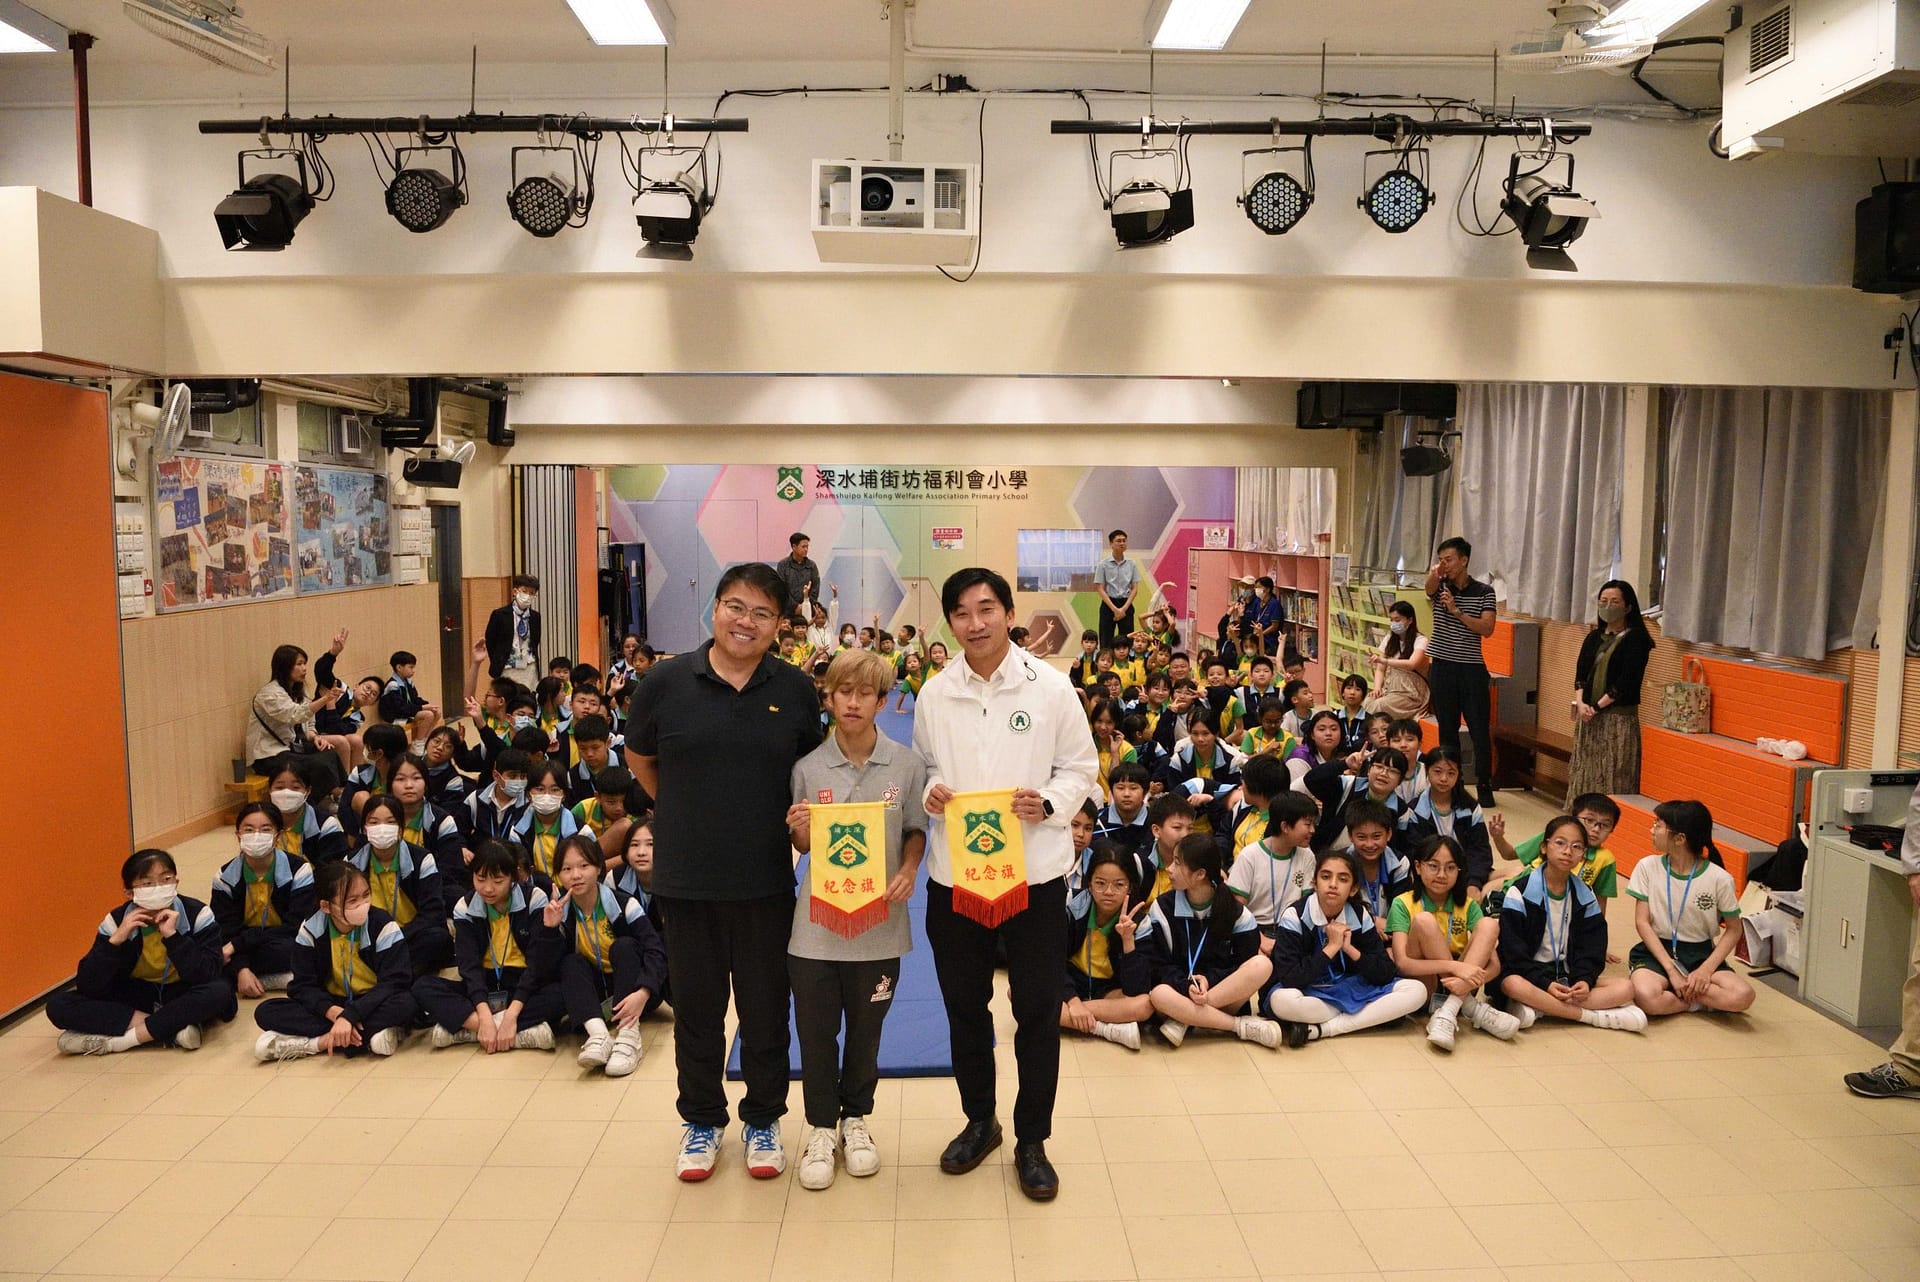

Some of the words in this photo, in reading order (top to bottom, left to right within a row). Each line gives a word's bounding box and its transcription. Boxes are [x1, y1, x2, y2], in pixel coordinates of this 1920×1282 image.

[816, 469, 1028, 489] 深水埔街坊福利會小學
[815, 492, 861, 500] Shamshuipo
[863, 492, 893, 501] Kaifong
[971, 493, 1000, 501] Primary
[965, 864, 1016, 881] 紀念旗
[824, 878, 876, 894] 紀念旗
